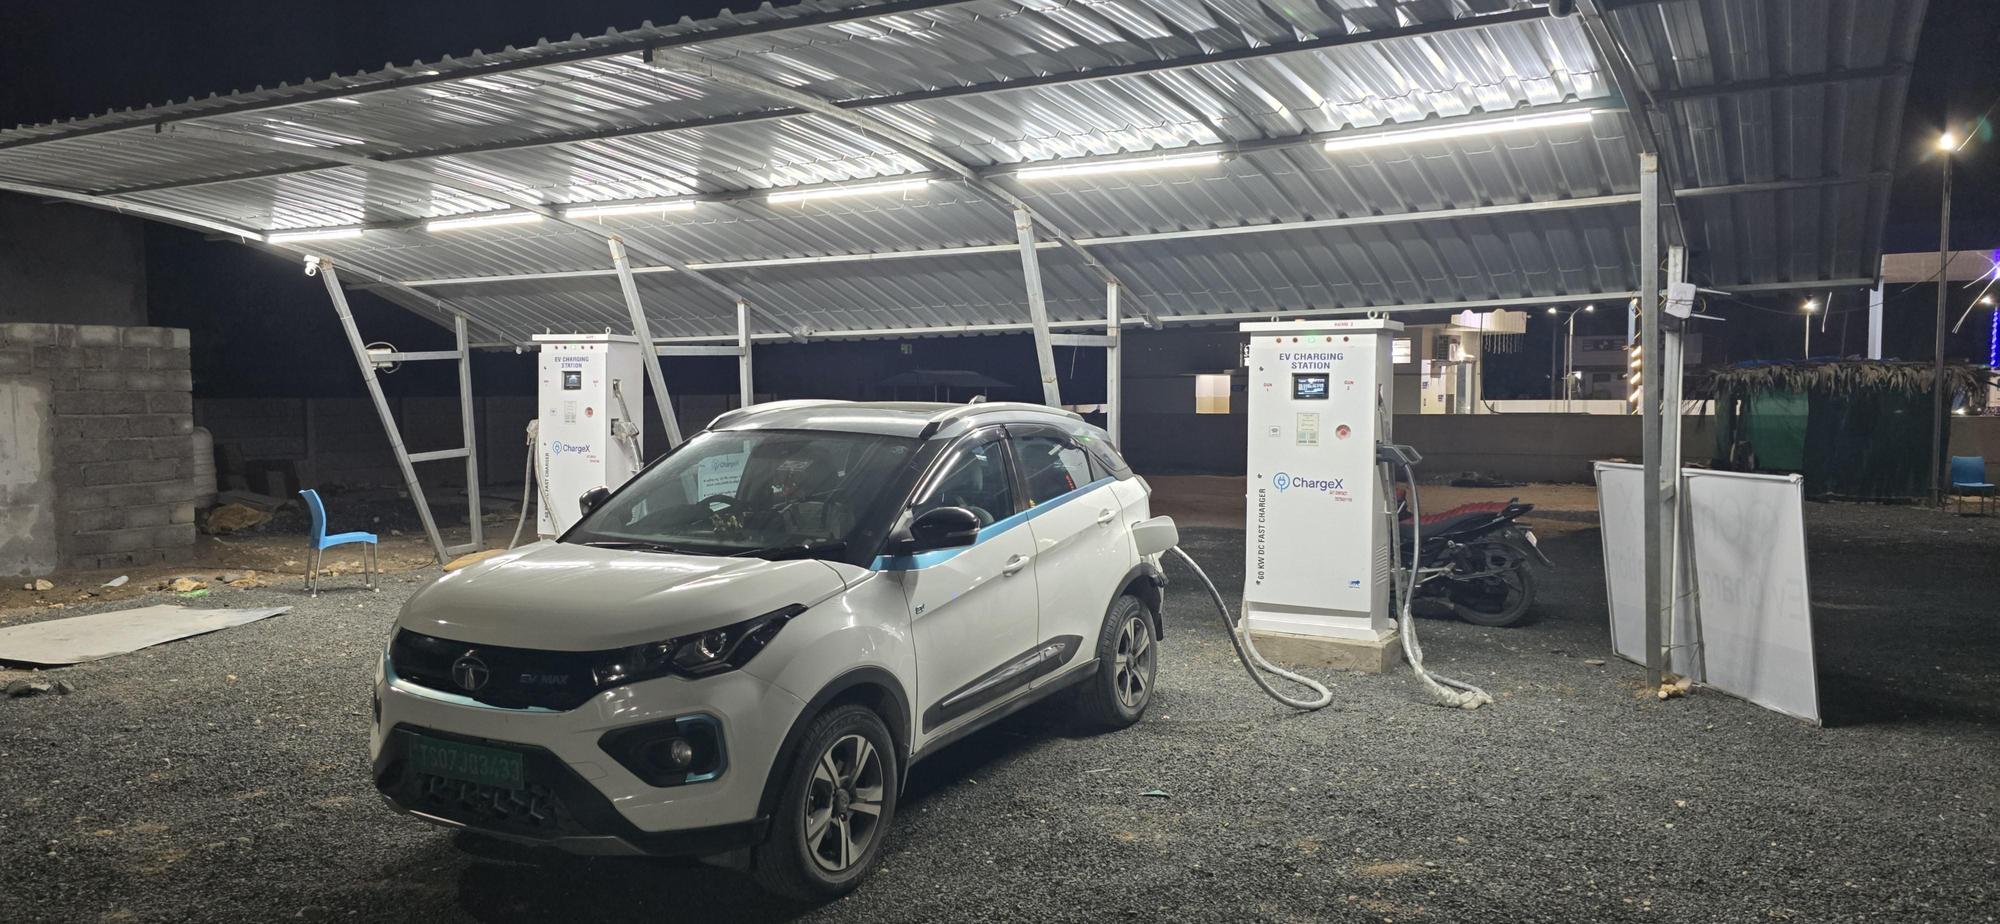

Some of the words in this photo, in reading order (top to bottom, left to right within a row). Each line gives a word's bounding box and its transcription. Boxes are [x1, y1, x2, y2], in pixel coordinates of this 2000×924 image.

[1279, 352, 1291, 361] EV
[1293, 352, 1344, 361] CHARGING
[1291, 361, 1331, 369] STATION
[563, 444, 590, 454] ChargeX
[1292, 477, 1344, 491] ChargeX
[1258, 488, 1266, 523] CHARGER
[1258, 524, 1266, 543] FAST
[1257, 544, 1265, 555] DC
[1257, 556, 1265, 570] KW
[1257, 570, 1265, 580] 60
[519, 673, 537, 684] EV
[541, 673, 569, 686] MAX
